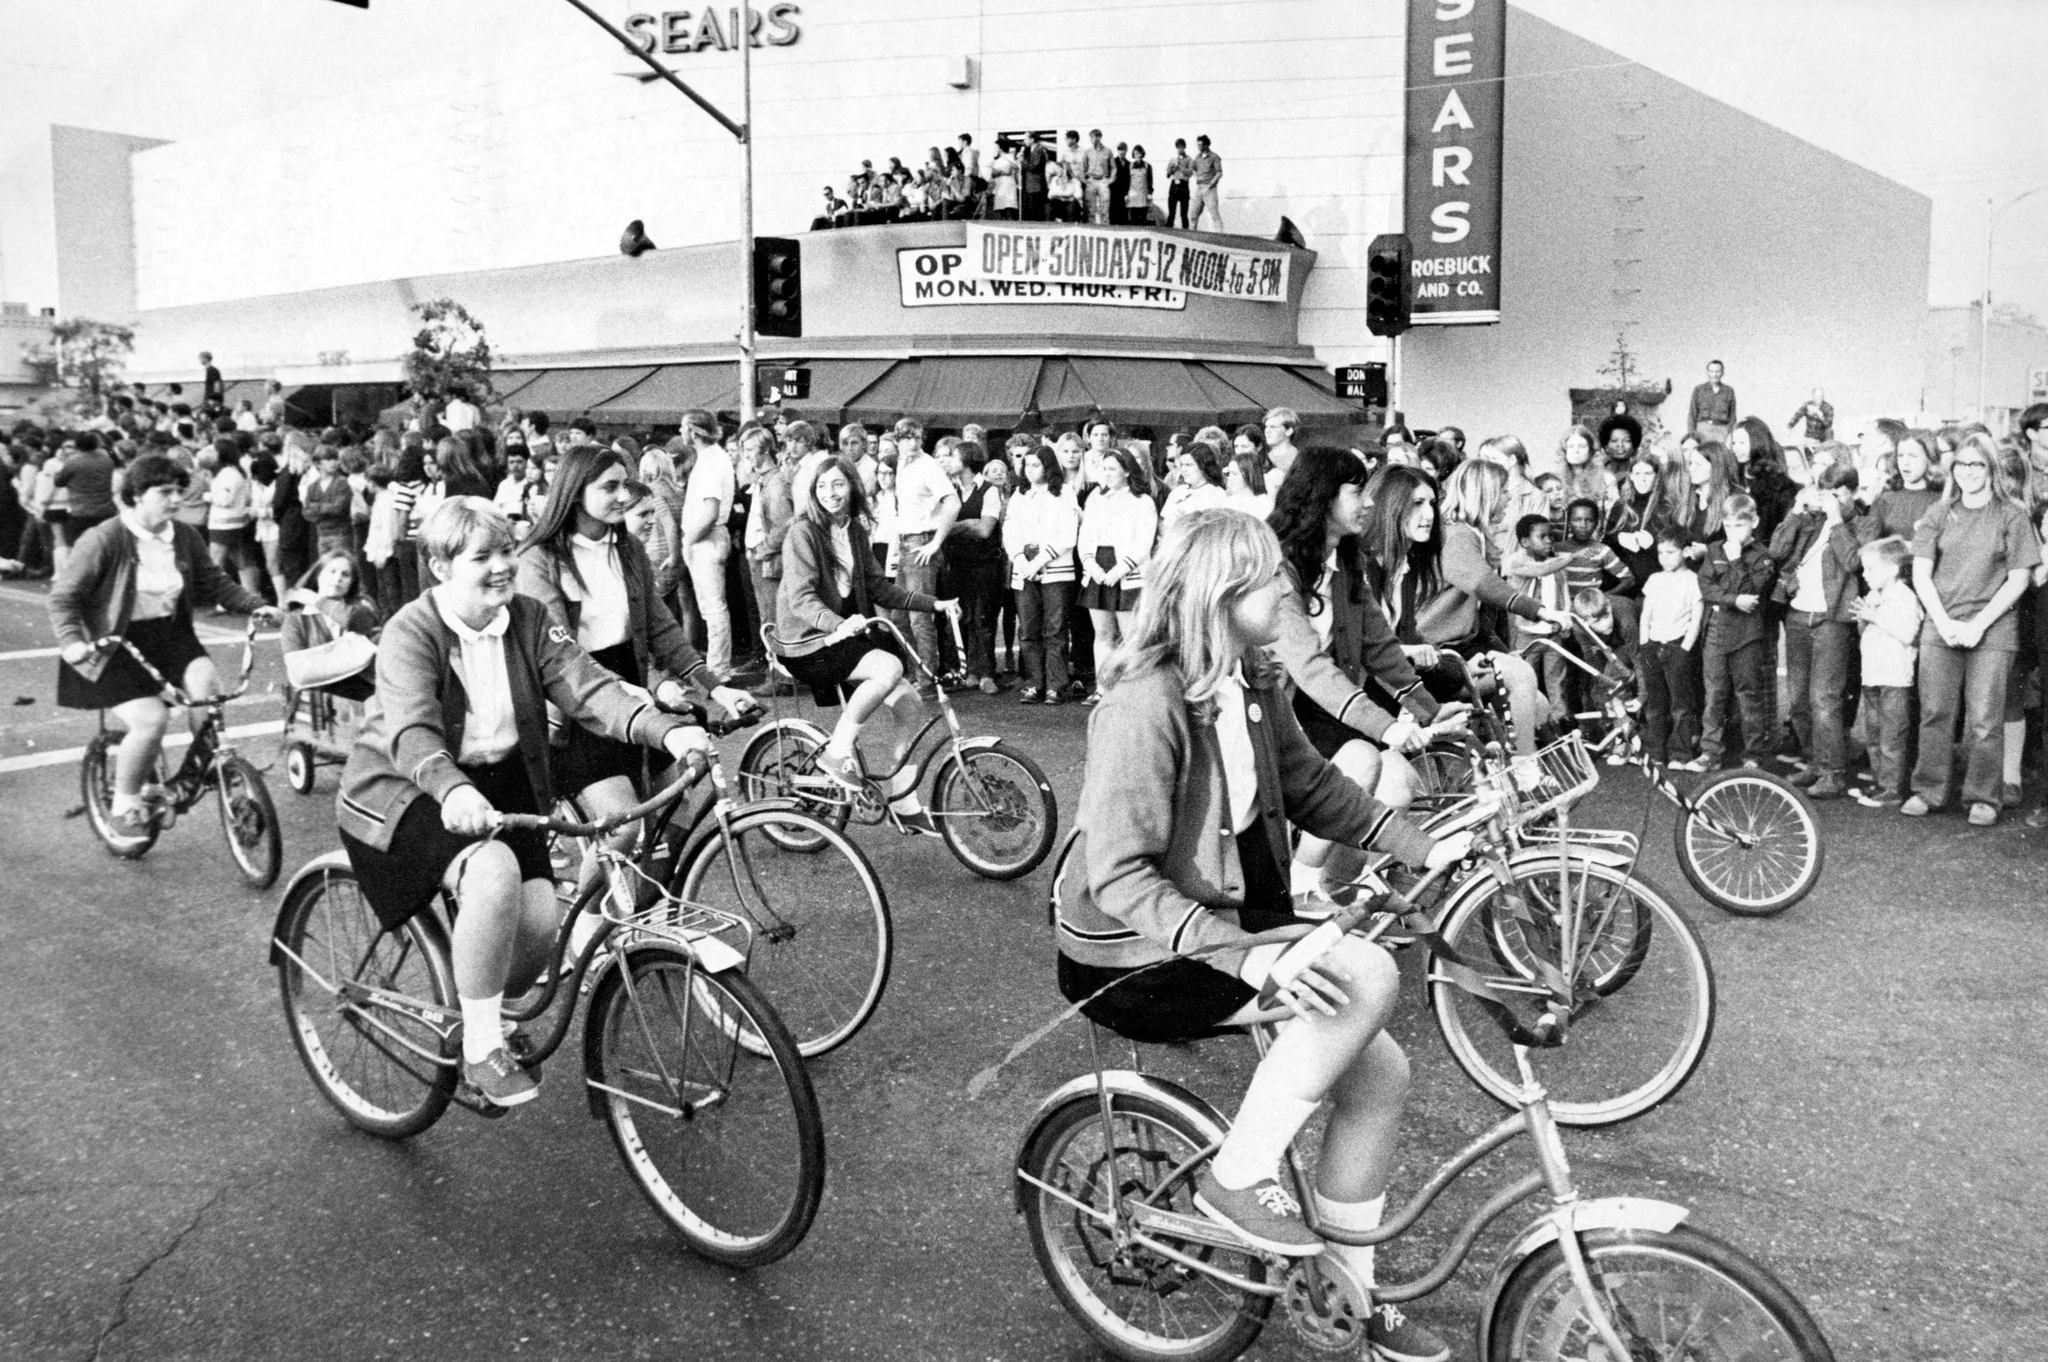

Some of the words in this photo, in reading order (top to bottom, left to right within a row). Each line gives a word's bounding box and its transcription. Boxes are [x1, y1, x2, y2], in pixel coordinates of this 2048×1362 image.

[624, 3, 802, 54] SEARS
[1430, 0, 1475, 243] SEARS
[915, 253, 962, 276] OP
[982, 232, 1041, 275] OPEN
[1049, 235, 1152, 279] SUNDAYS
[1155, 240, 1176, 283] 12
[1179, 247, 1229, 292] NOON
[1229, 263, 1244, 294] to
[1411, 254, 1491, 278] ROEBUCK
[915, 279, 984, 299] MON.
[990, 280, 1052, 297] WED.
[1055, 282, 1122, 299] THUR.
[1129, 285, 1177, 302] FRI.
[1417, 282, 1450, 299] AND
[1456, 280, 1484, 297] CO.
[1346, 368, 1366, 381] DON
[1346, 384, 1366, 397] WAL
